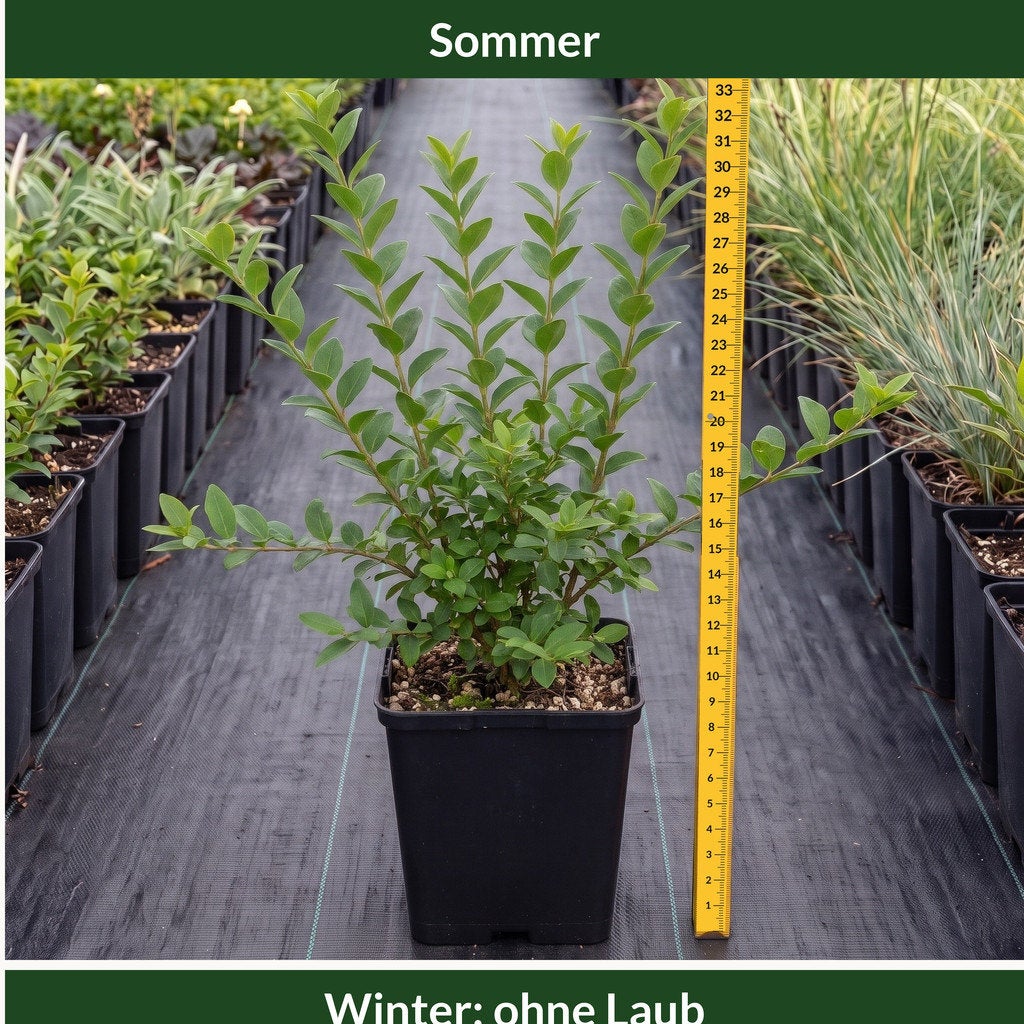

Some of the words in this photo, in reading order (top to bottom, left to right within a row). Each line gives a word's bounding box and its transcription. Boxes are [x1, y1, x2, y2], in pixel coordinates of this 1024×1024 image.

[716, 84, 733, 96] 33
[715, 109, 732, 122] 32
[715, 135, 731, 147] 31
[714, 160, 731, 173] 30
[714, 186, 731, 198] 29
[713, 211, 730, 224] 28
[713, 237, 729, 249] 27
[712, 263, 729, 274] 26
[712, 288, 728, 300] 25
[711, 314, 728, 325] 24
[711, 339, 727, 351] 23
[711, 364, 726, 376] 22
[710, 390, 725, 401] 21
[710, 416, 725, 427] 20
[711, 441, 725, 452] 19
[710, 467, 724, 478] 18
[710, 492, 724, 503] 17
[709, 518, 723, 528] 16
[709, 544, 722, 554] 15
[708, 569, 722, 579] 14
[708, 594, 721, 605] 13
[708, 620, 720, 630] 12
[707, 646, 719, 655] 11
[707, 671, 720, 681] 10
[709, 697, 715, 707] 9
[708, 722, 715, 732] 8
[708, 748, 714, 757] 7
[707, 773, 714, 783] 6
[707, 799, 713, 808] 5
[707, 825, 713, 833] 4
[706, 850, 712, 859] 3
[706, 876, 712, 884] 2
[706, 901, 711, 910] 1
